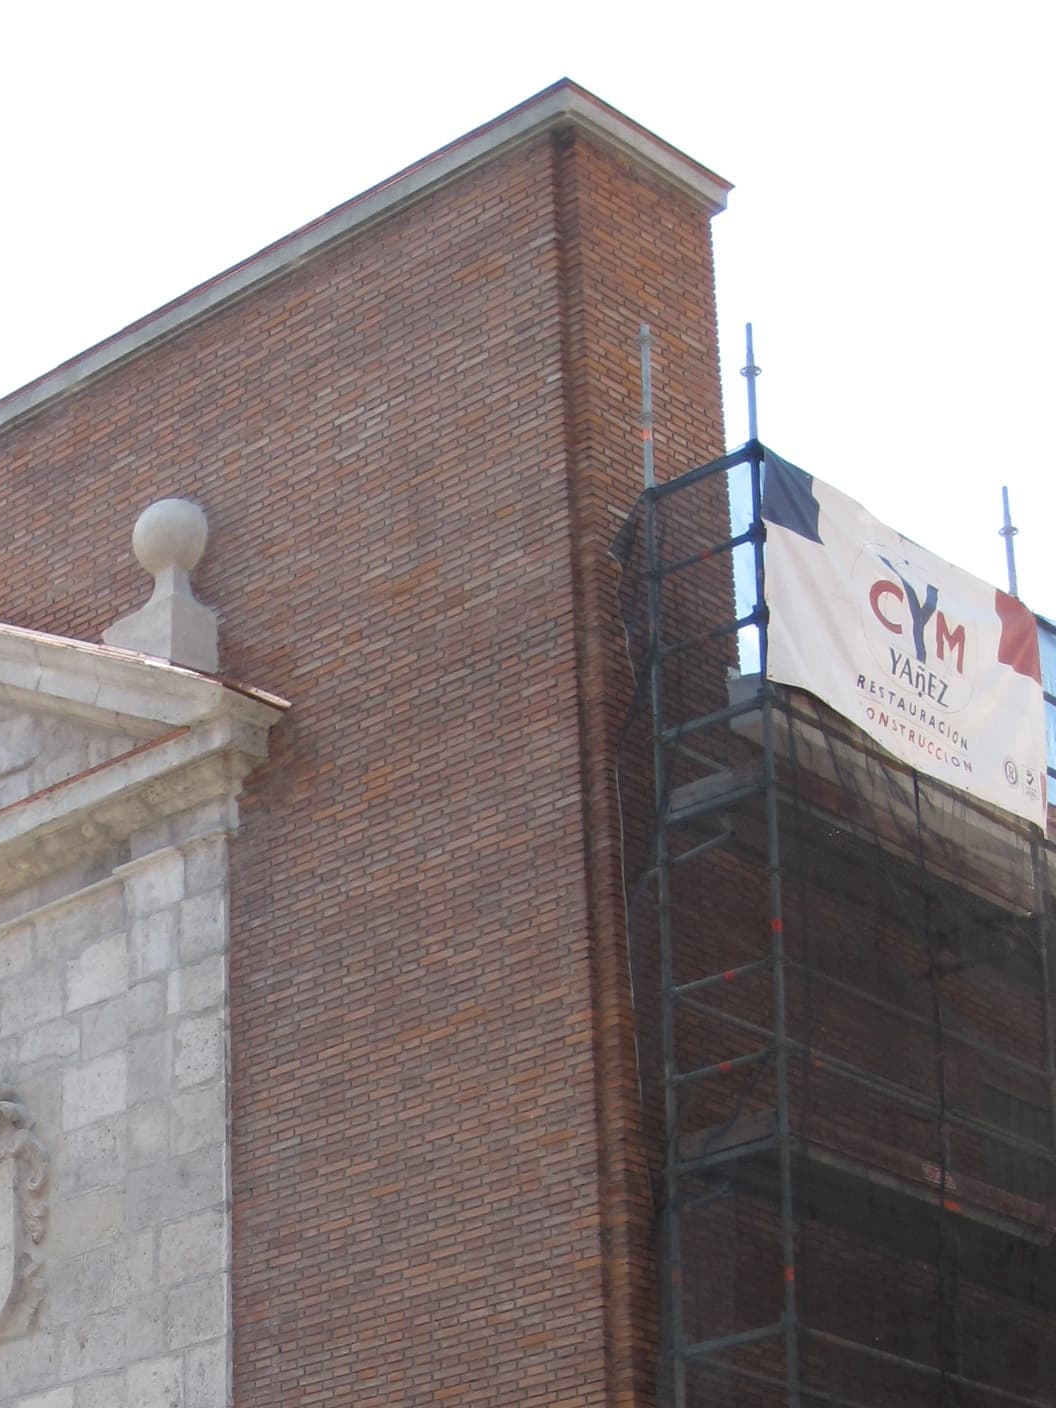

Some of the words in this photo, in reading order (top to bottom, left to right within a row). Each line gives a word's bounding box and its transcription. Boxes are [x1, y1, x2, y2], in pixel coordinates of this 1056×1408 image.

[869, 555, 965, 674] CYM
[857, 675, 968, 750] RESTAURACION
[860, 701, 973, 773] ONSTRUCCION
